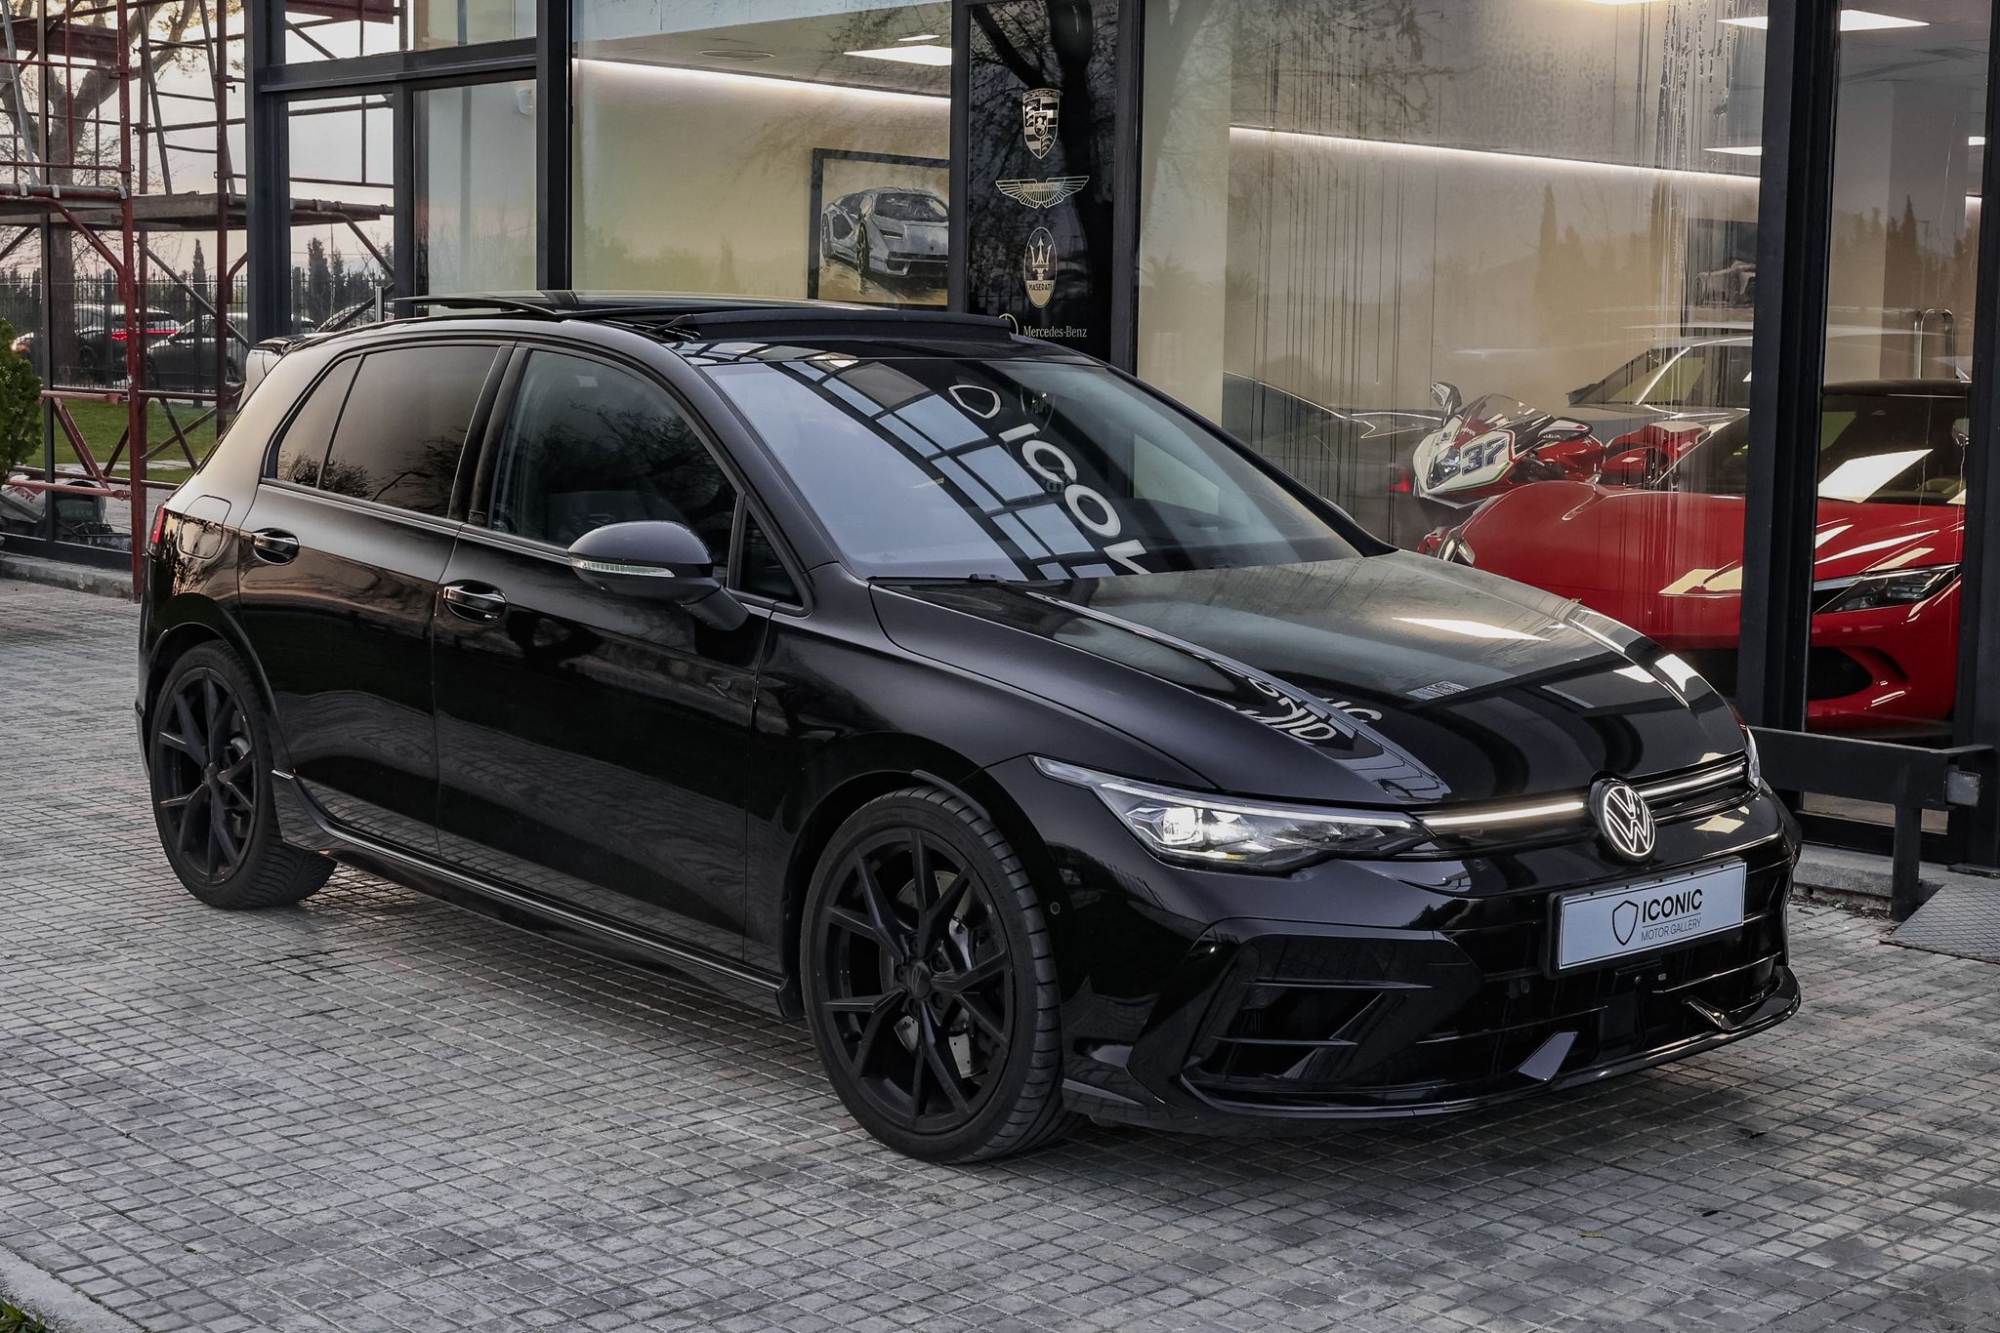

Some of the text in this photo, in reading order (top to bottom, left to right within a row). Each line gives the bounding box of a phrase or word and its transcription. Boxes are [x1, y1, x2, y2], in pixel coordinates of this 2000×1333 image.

[1028, 283, 1052, 291] MASERATI
[1023, 325, 1088, 337] Mercedes-Benz
[1462, 436, 1508, 476] 37
[1642, 889, 1703, 923] ICONIC
[1641, 917, 1702, 941] MOTOR GALLERY
